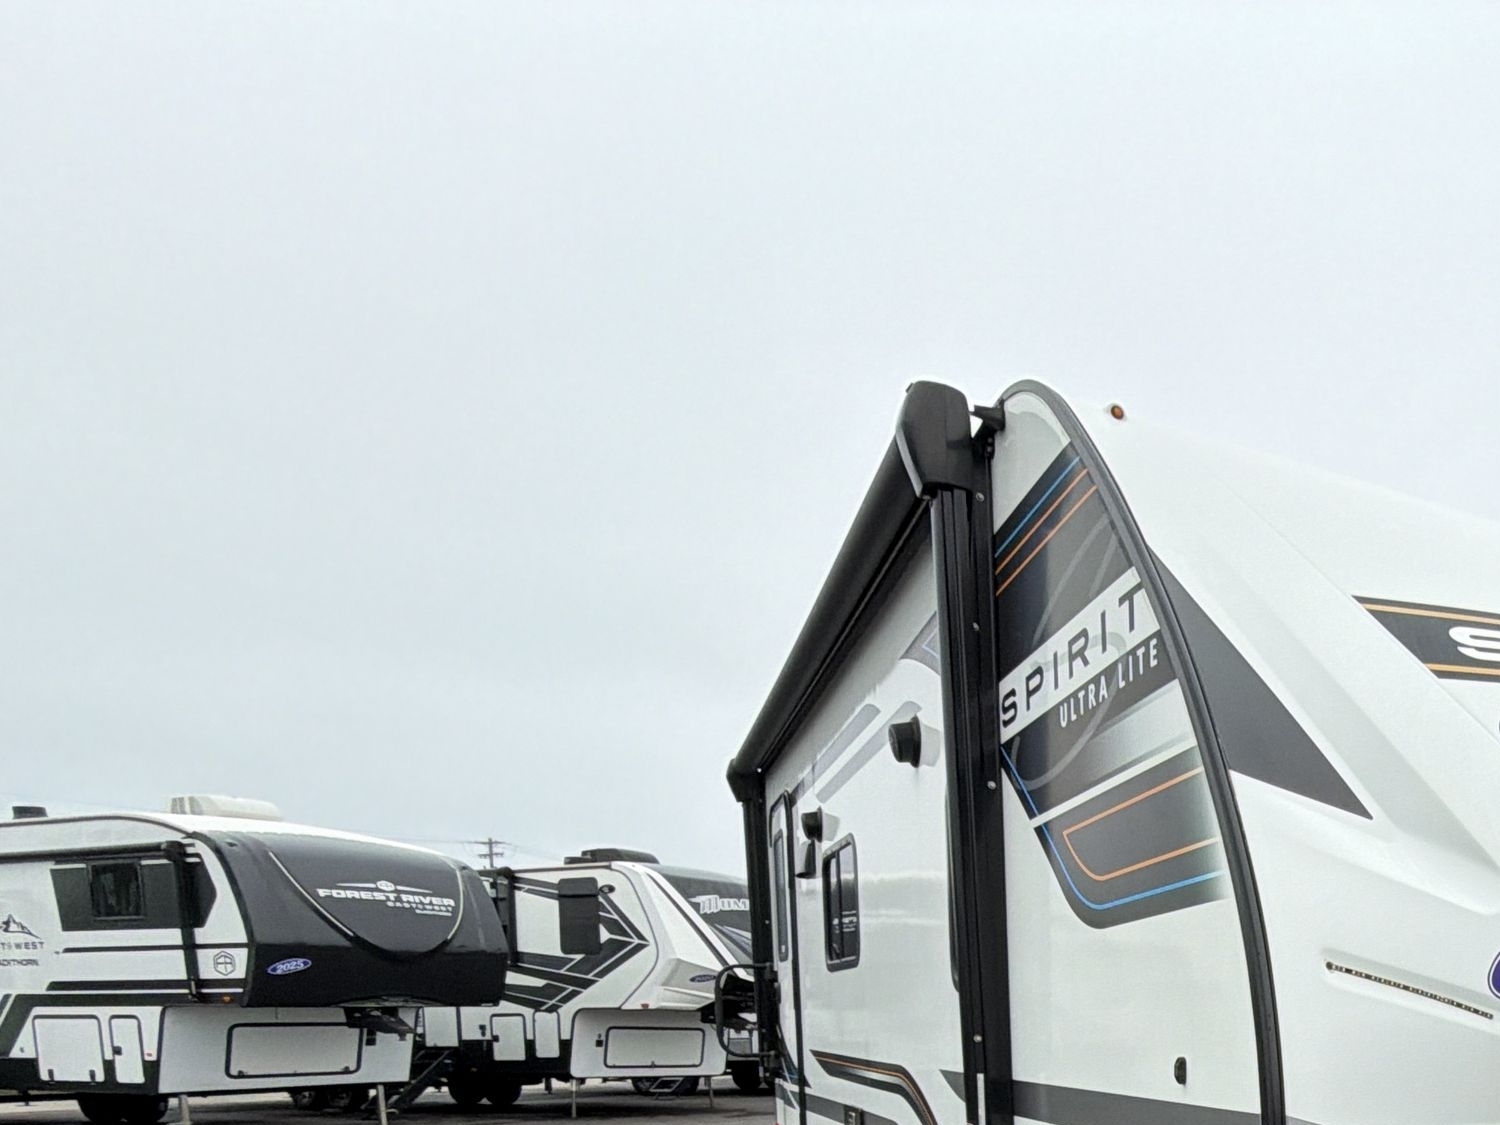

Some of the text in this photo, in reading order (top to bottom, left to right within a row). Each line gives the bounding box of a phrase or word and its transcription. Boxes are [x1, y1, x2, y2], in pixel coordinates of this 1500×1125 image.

[1001, 587, 1146, 729] SPIRIT
[1059, 637, 1159, 729] ULTRA LITE
[316, 888, 456, 907] FOREST RIVER
[276, 960, 305, 975] 2025
